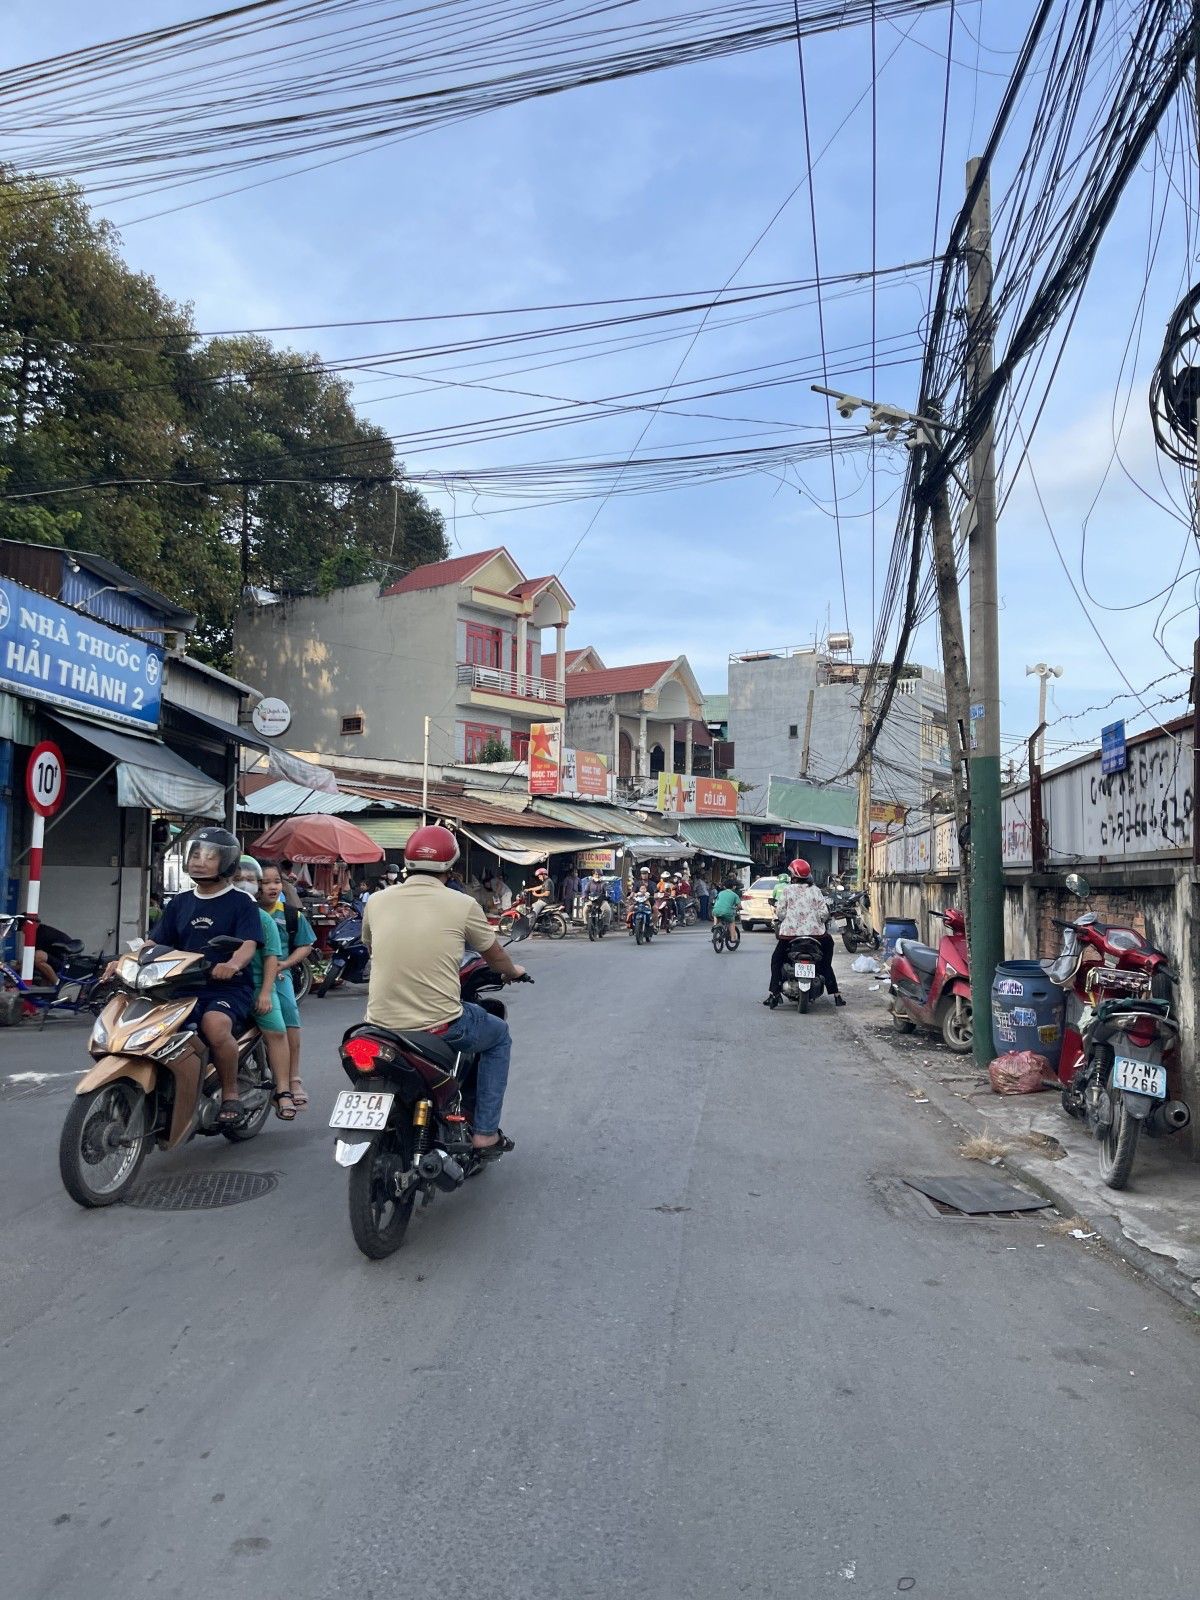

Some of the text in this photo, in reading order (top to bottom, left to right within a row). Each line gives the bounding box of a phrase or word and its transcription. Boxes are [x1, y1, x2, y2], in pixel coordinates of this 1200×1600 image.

[20, 607, 141, 672] NHÀ THUỐC
[6, 639, 145, 711] HẢI THÀNH 2
[704, 791, 727, 806] CÔ LIÊN
[1122, 1060, 1158, 1079] 77-N7
[1122, 1075, 1158, 1094] 1266
[344, 1094, 383, 1111] 83-CA
[334, 1110, 384, 1127] 217.52
